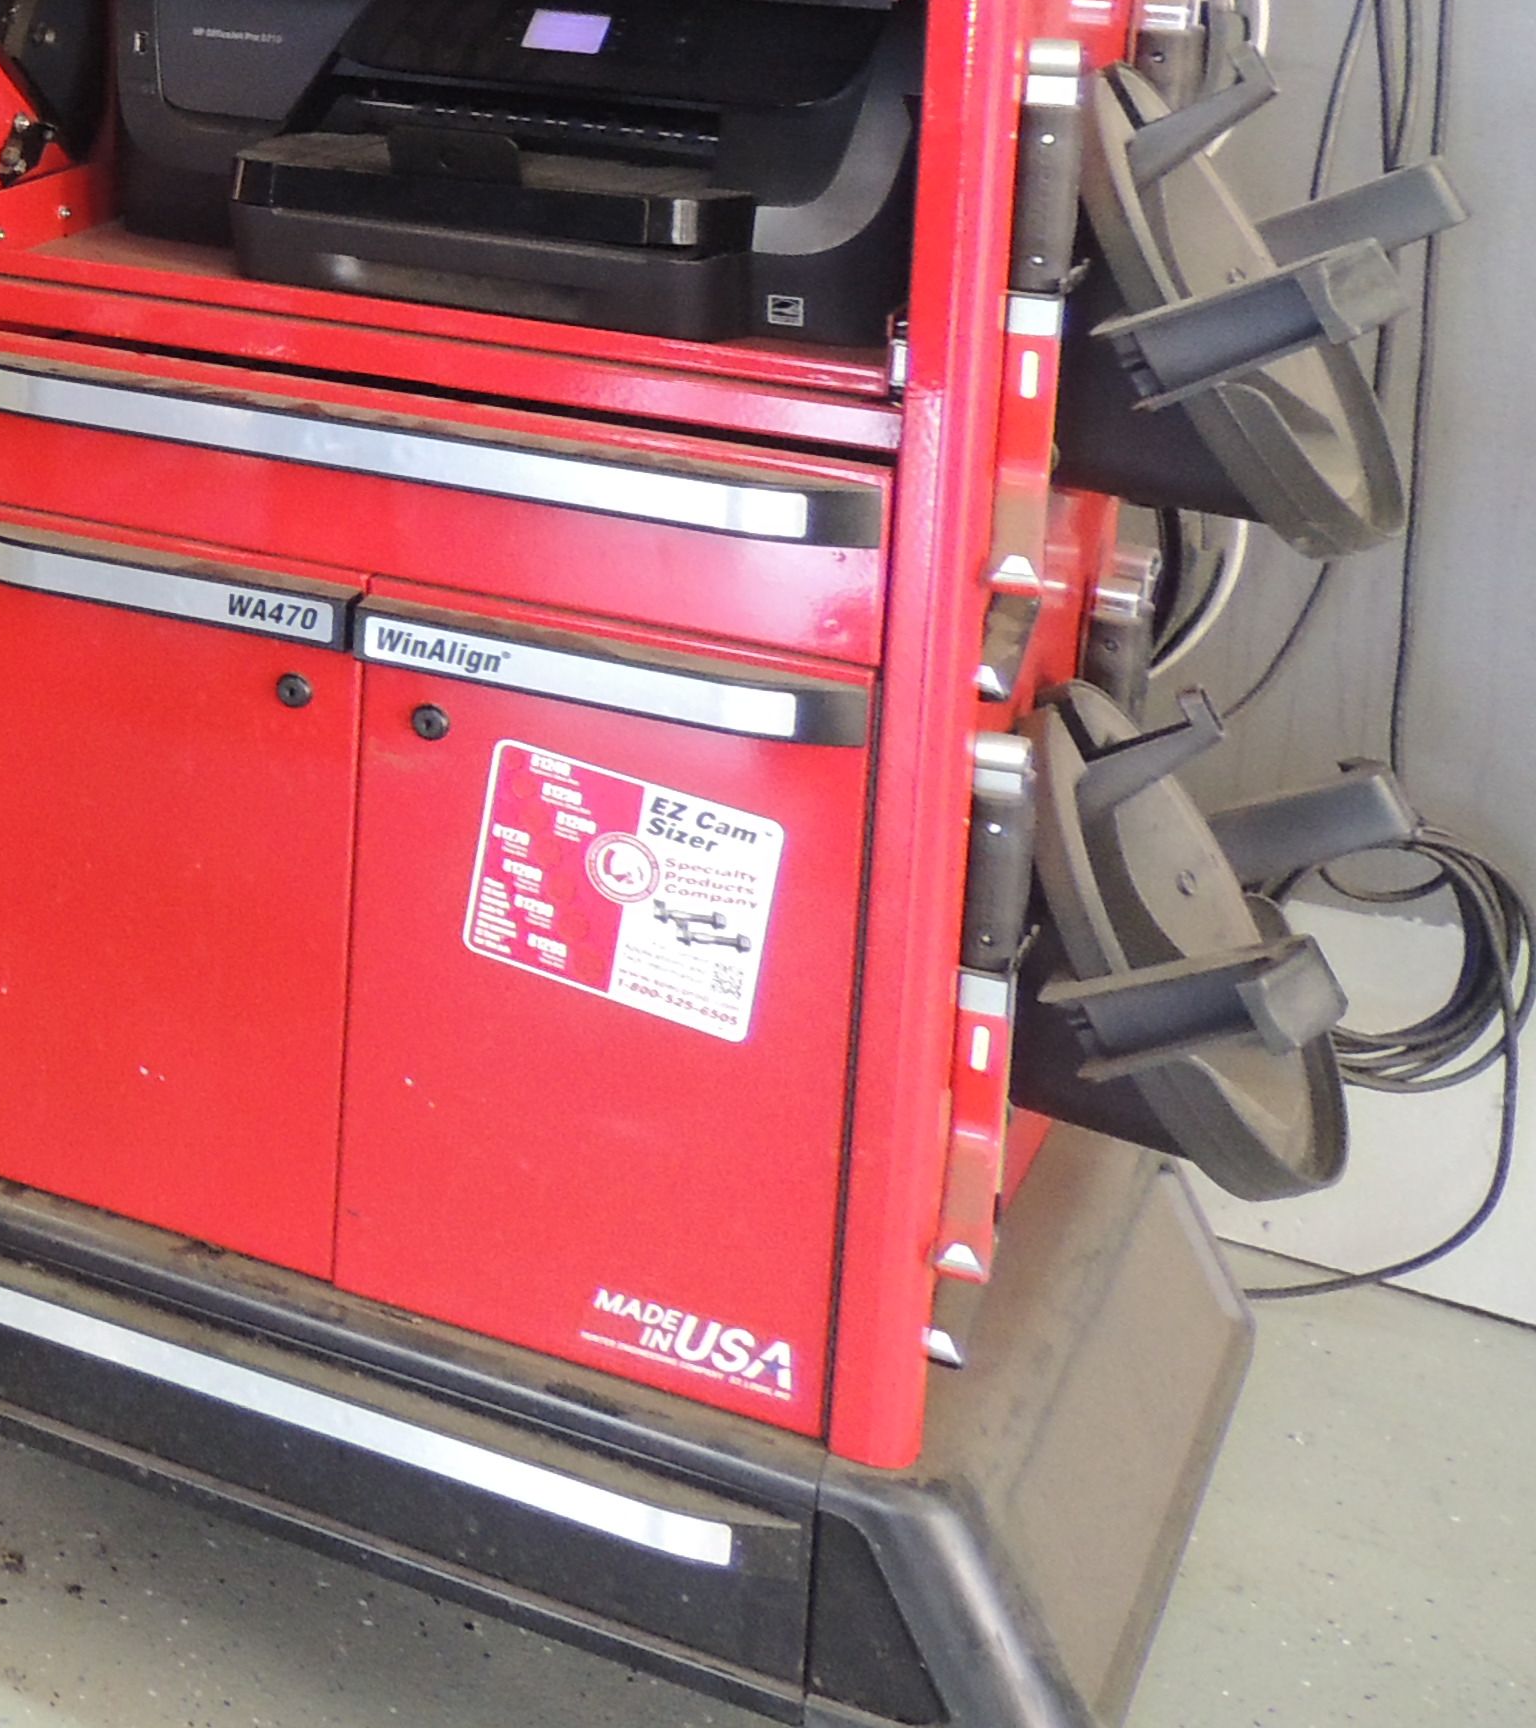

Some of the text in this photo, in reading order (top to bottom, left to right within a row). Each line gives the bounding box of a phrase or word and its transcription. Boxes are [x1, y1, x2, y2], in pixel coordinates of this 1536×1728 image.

[228, 592, 318, 630] WA470
[646, 818, 718, 852] Sizer
[650, 796, 758, 844] EZ Cam
[664, 871, 755, 896] Products
[665, 858, 758, 883] Specialty
[664, 884, 759, 910] Company
[593, 1288, 683, 1332] MADE
[639, 1326, 674, 1353] IN
[674, 1313, 792, 1391] USA
